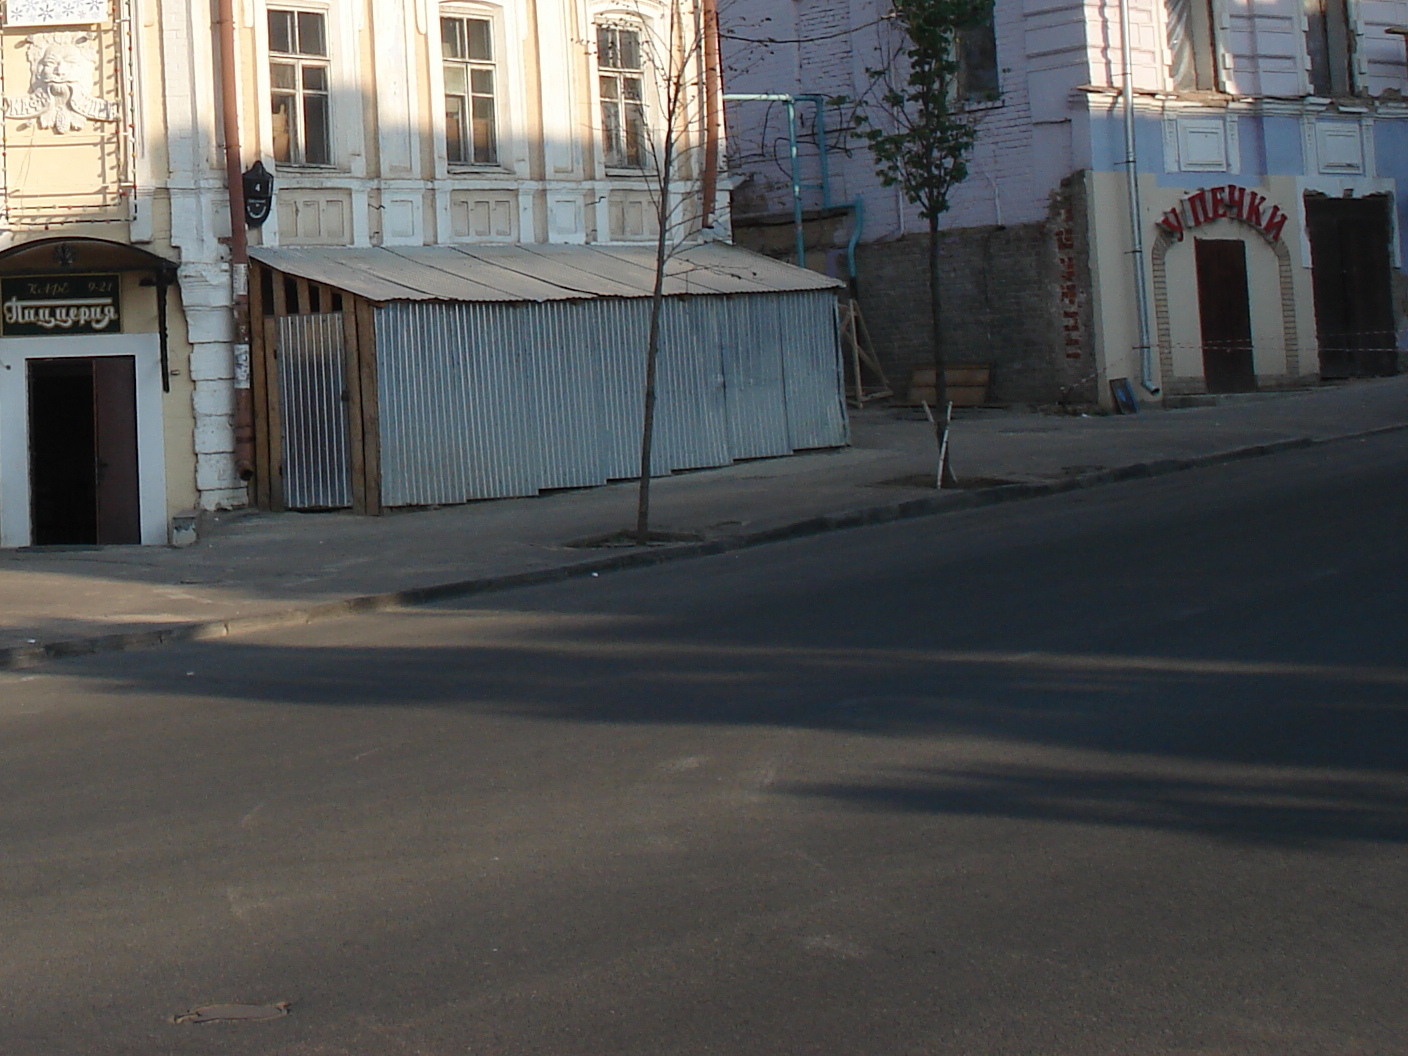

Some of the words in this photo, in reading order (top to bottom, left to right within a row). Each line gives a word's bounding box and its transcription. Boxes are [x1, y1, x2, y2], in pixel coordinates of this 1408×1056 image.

[254, 183, 261, 192] 4
[1160, 207, 1185, 243] У
[1187, 184, 1288, 242] ПЕЧКИ
[4, 296, 118, 330] Пиццерия
